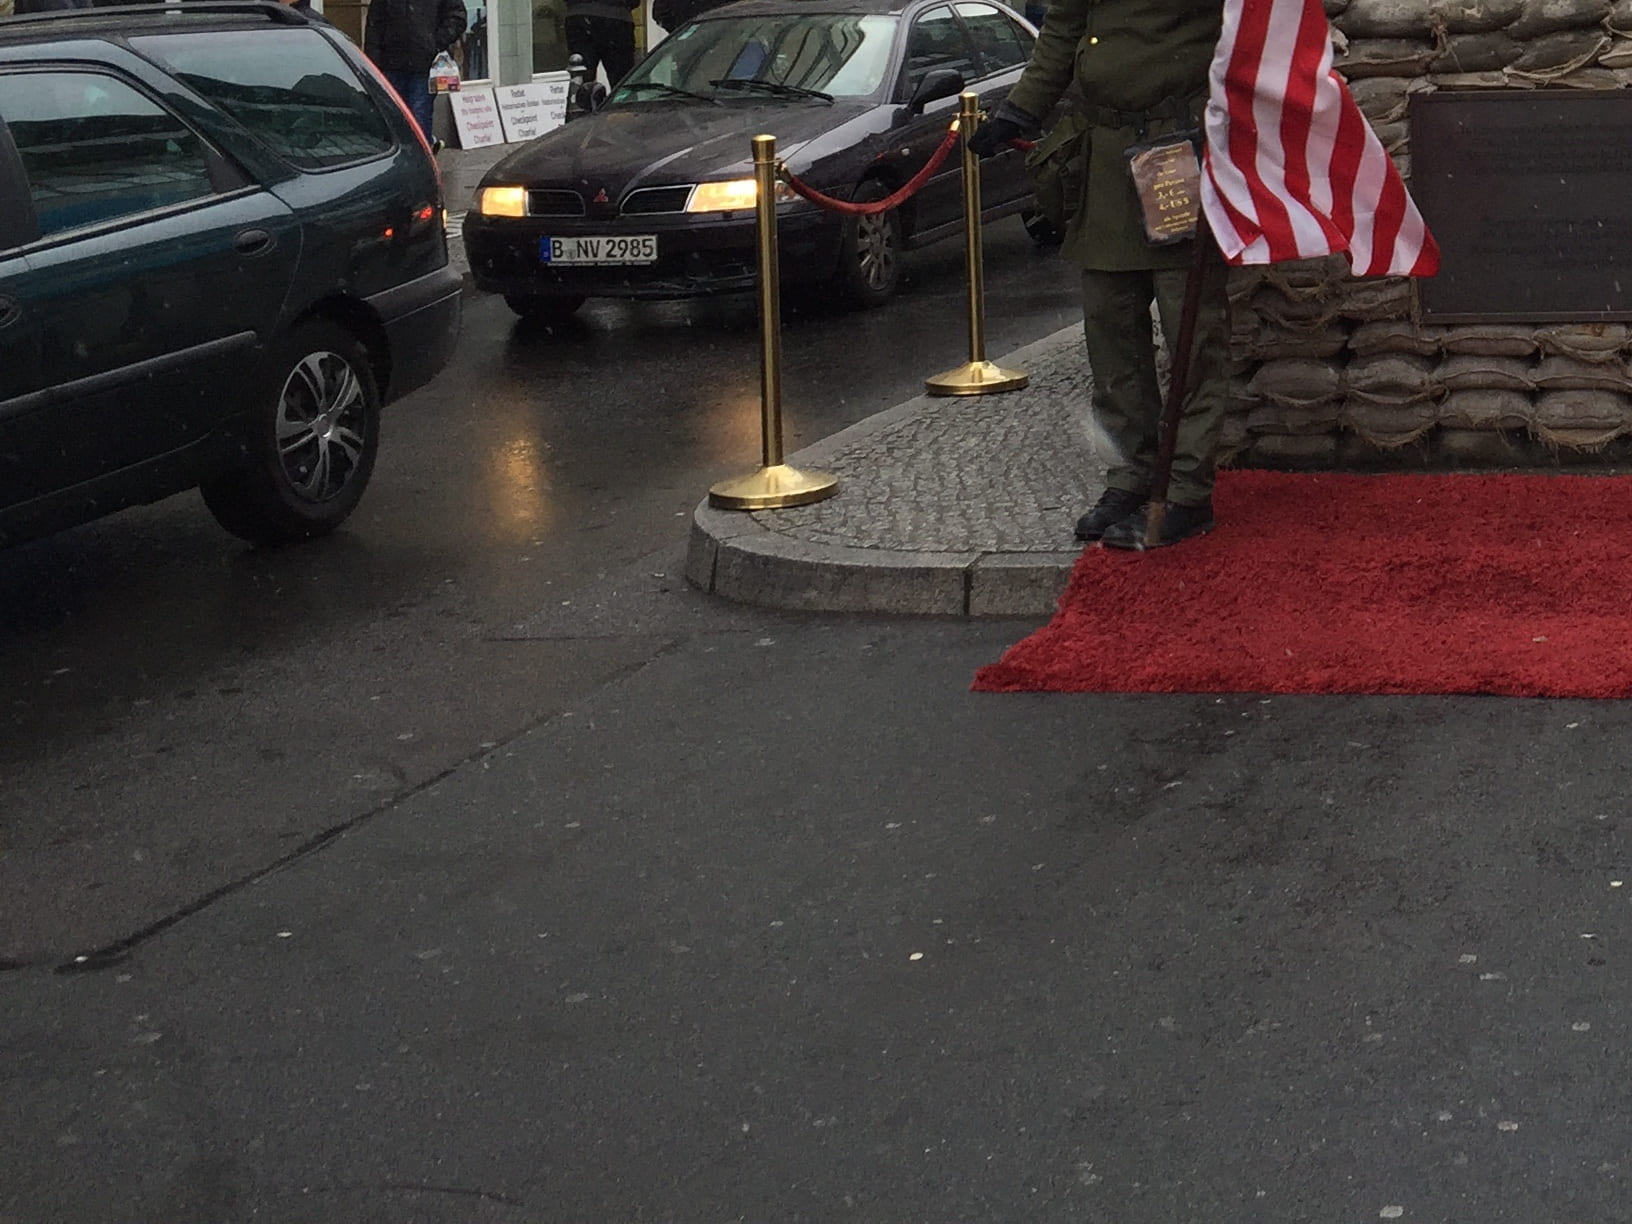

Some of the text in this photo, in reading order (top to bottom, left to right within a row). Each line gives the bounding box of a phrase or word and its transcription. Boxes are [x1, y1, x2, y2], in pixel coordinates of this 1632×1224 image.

[552, 239, 653, 258] B NV 2985
